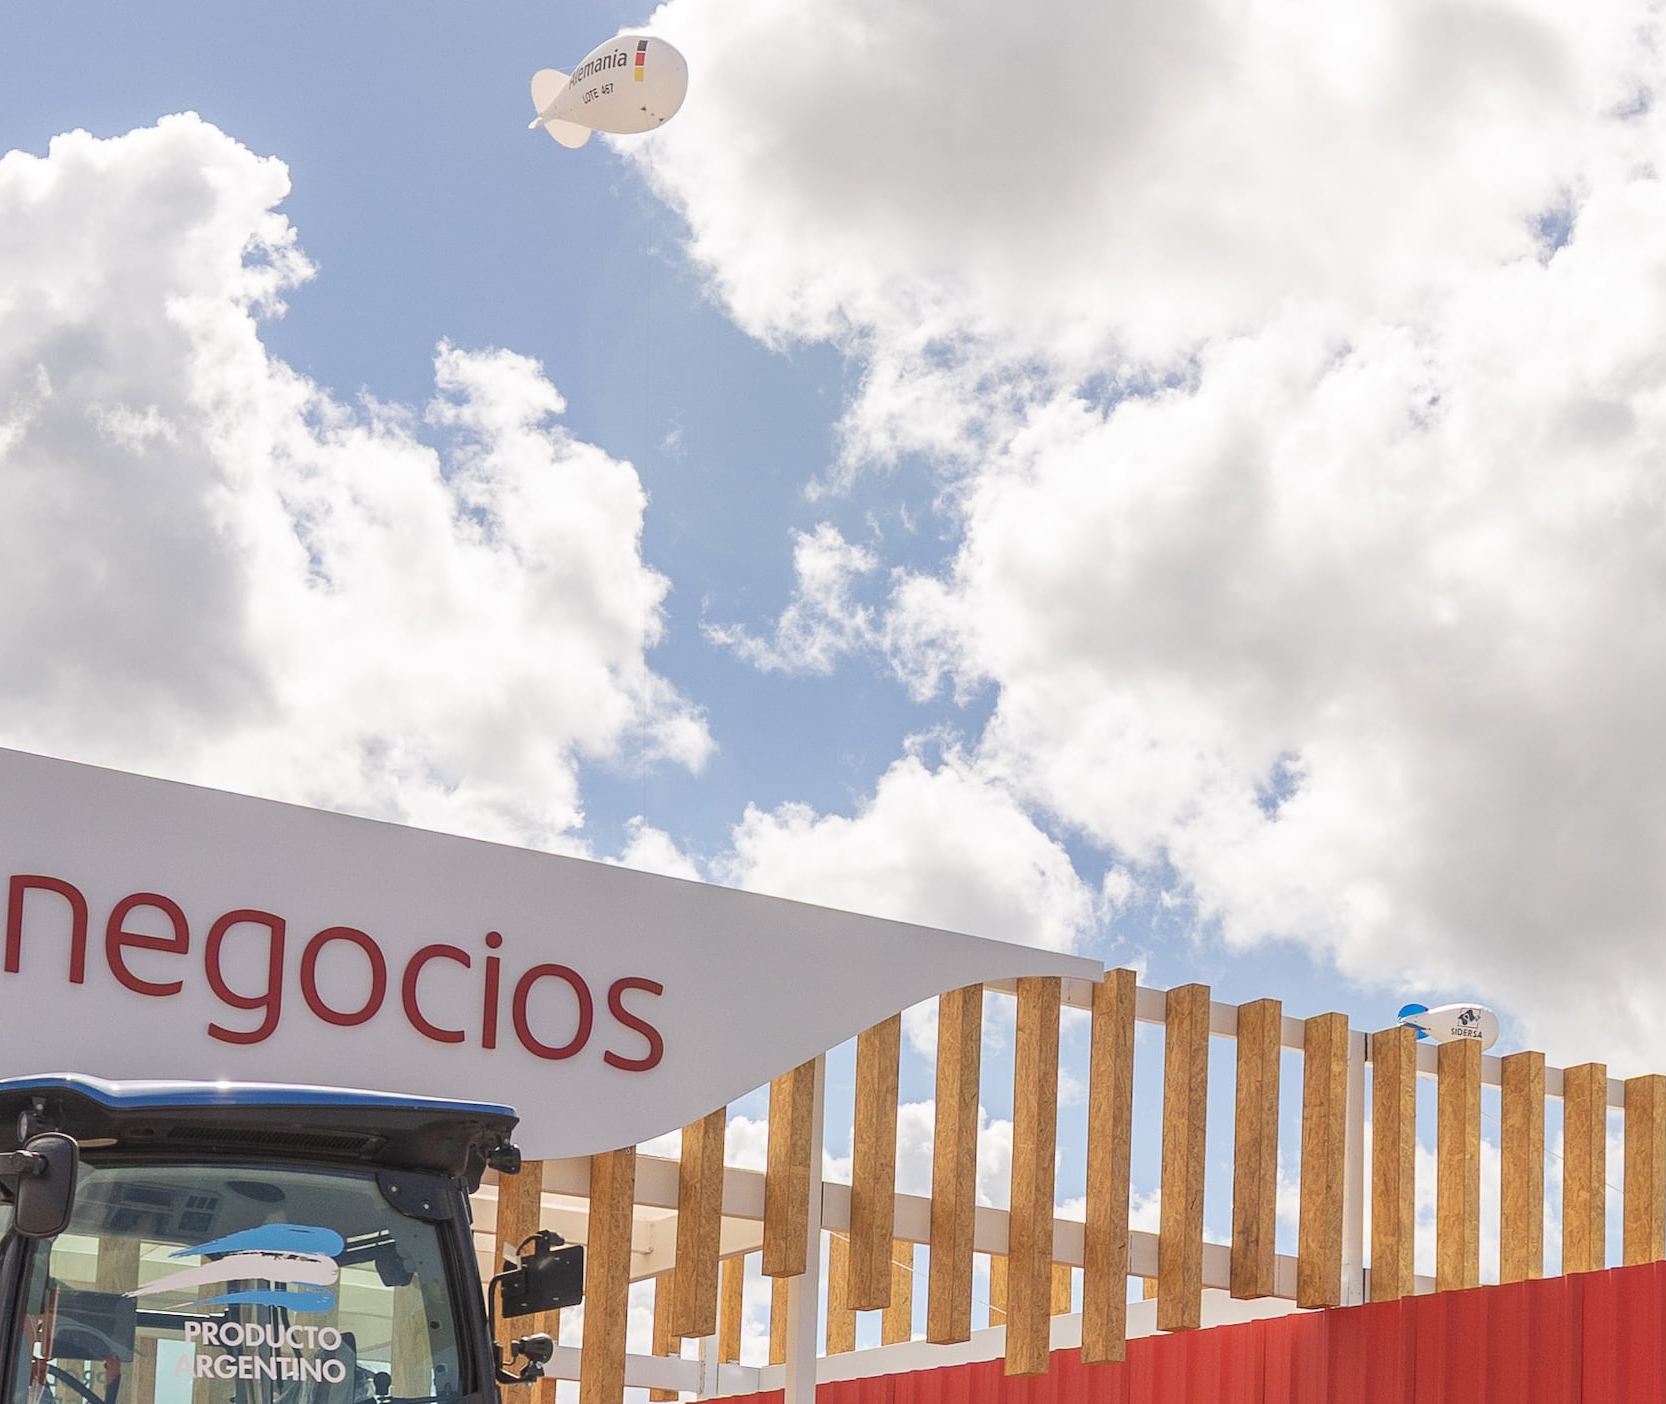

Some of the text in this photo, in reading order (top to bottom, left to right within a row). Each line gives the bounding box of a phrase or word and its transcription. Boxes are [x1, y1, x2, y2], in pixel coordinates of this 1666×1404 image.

[569, 48, 627, 90] Alemania
[582, 82, 614, 104] LOTE 467
[1451, 1027, 1483, 1039] SIDERSA
[184, 1321, 343, 1351] PRODUCTO
[174, 1353, 347, 1384] ARGENTINO
